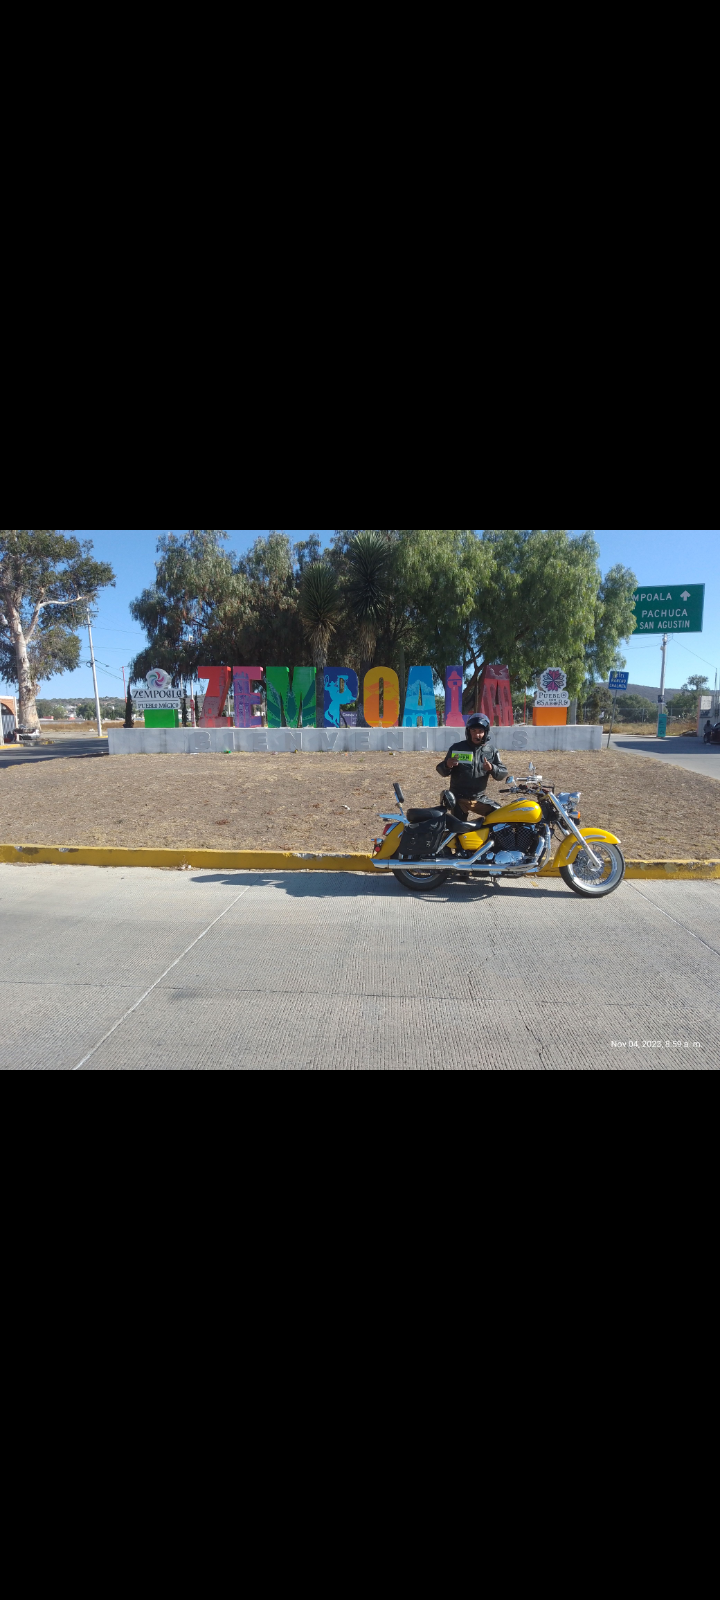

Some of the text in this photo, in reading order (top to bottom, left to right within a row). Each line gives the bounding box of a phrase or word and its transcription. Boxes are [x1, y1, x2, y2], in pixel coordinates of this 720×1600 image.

[632, 592, 672, 602] MPOALA
[641, 608, 688, 618] PACHUCA
[639, 620, 690, 630] SAN AGUSTIN
[198, 665, 514, 728] ZEMPOALA
